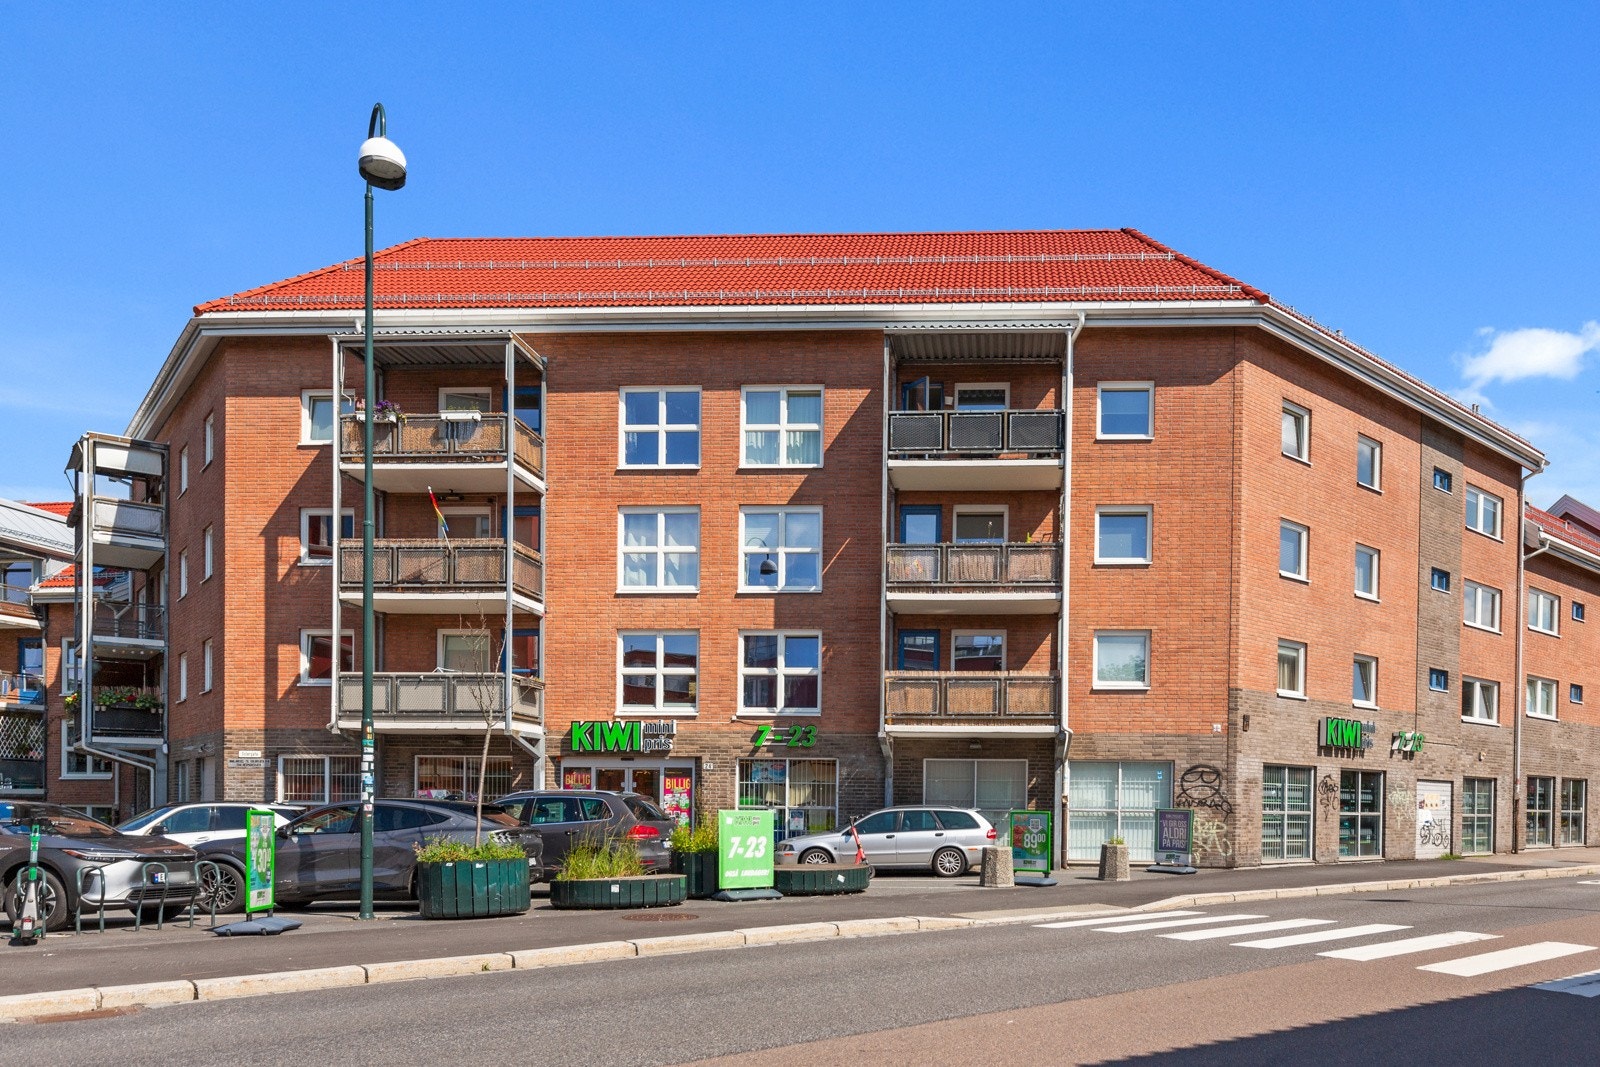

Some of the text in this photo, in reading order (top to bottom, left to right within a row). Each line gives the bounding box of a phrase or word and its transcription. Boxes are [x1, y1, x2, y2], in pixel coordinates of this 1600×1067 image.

[644, 719, 676, 734] mini
[1326, 717, 1362, 748] KIWI
[571, 721, 641, 752] KIWI
[643, 735, 673, 753] pris
[565, 773, 591, 785] BILLIG
[665, 778, 690, 789] BILLIG
[1162, 827, 1187, 839] ALDRI
[728, 836, 767, 858] 7-23
